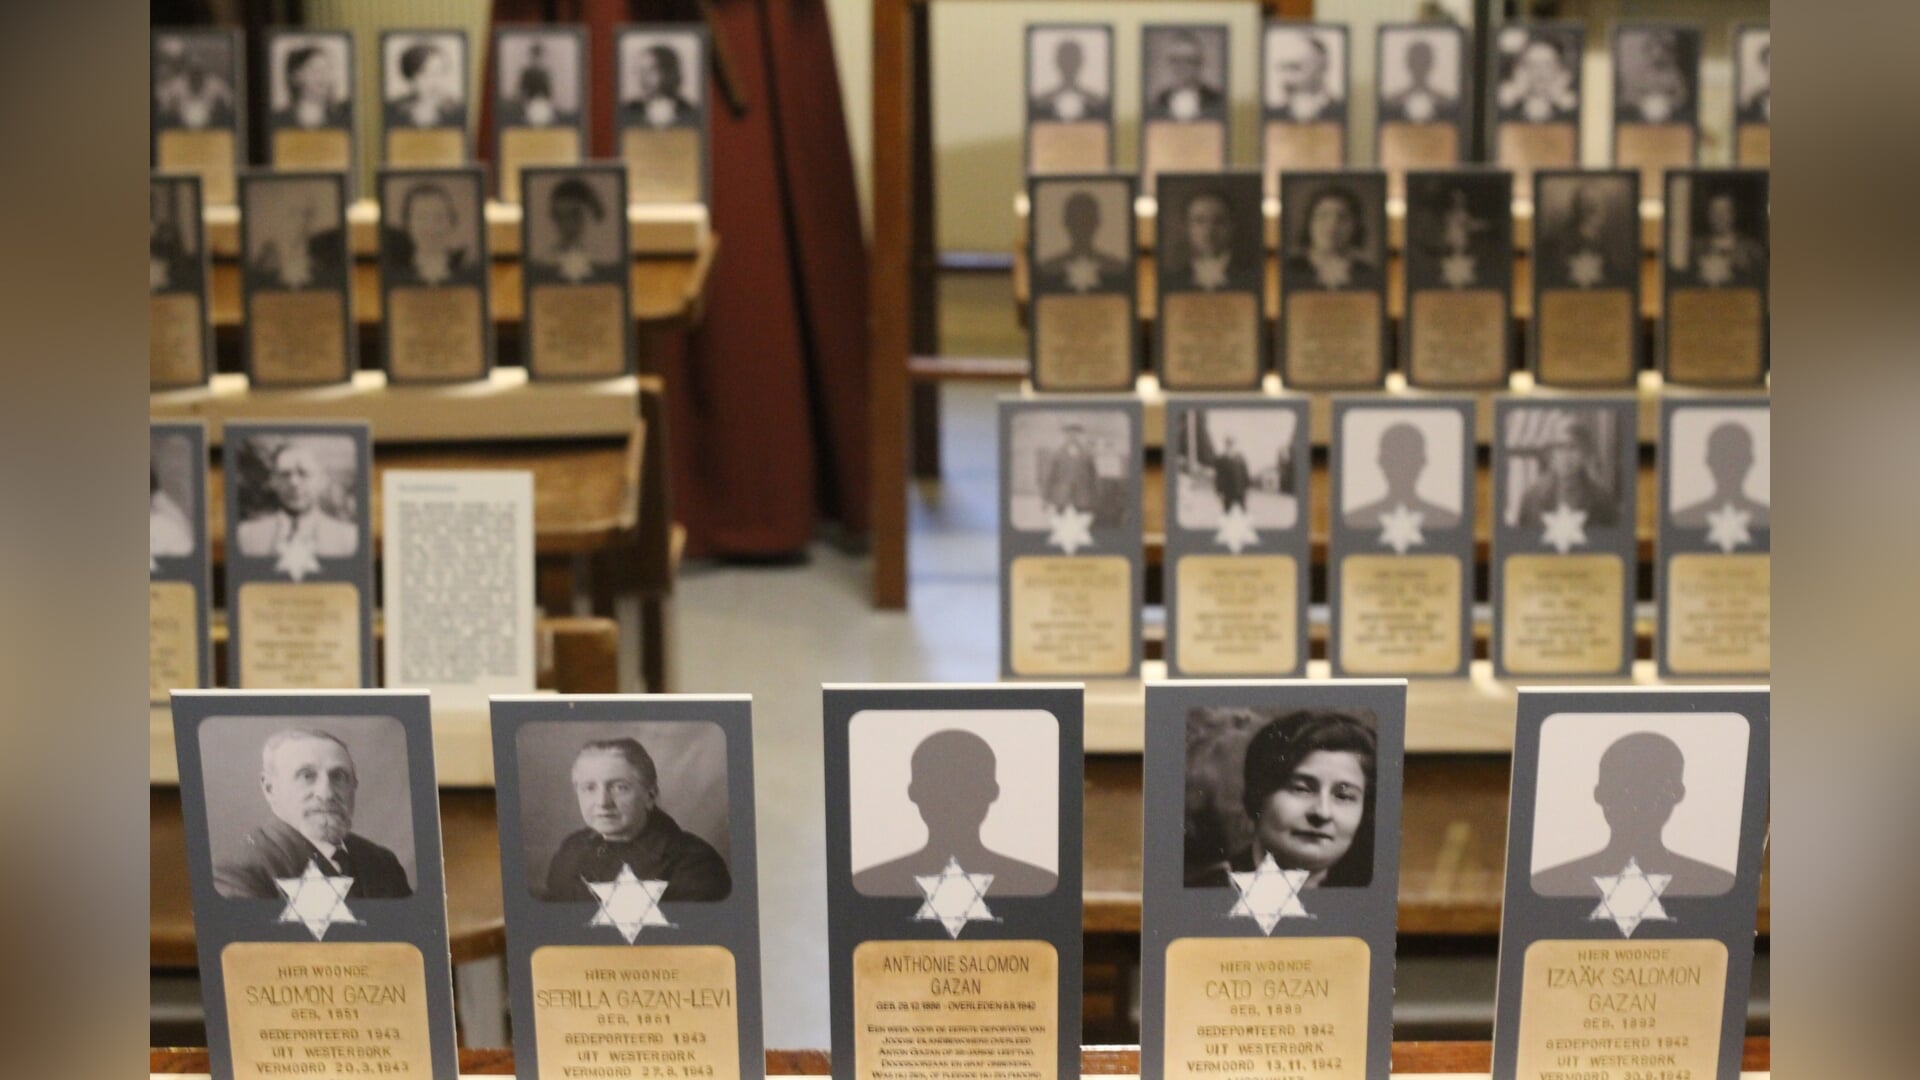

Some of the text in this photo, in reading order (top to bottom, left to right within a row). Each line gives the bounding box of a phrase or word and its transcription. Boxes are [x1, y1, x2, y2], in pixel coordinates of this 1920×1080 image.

[1578, 949, 1671, 961] HIER WOONDE
[278, 965, 369, 977] HIER WOONDE
[882, 955, 1030, 974] ANTHONIE SALOMON
[1220, 959, 1312, 973] HIER WOONDE
[584, 968, 680, 982] HIER WOONDE
[1548, 965, 1701, 988] IZAÄK SALOMON
[931, 978, 981, 996] GAZAN
[1206, 979, 1329, 999] CATO GAZAN
[246, 984, 406, 1005] SALOMON GAZAN
[617, 988, 731, 1008] GAZAN-LEVI
[948, 1001, 1002, 1010] OVERLEDEN
[1589, 993, 1656, 1012] GAZAN
[259, 1027, 400, 1042] GEDEPORTEERD 1943
[1197, 1024, 1335, 1037] GEDEPORTEERD 1942
[565, 1032, 706, 1045] GEDEPORTEERD 1943
[1546, 1036, 1689, 1050] GEDEPORTEERD 1942
[272, 1046, 391, 1059] UIT WESTERBORK
[1206, 1042, 1324, 1056] UIT WESTERBORK
[578, 1050, 696, 1063] UIT WESTERBORK
[1557, 1054, 1676, 1067] UIT WESTERBORK
[256, 1062, 326, 1075] VERMOORD
[562, 1066, 631, 1079] VERMOORD
[1187, 1060, 1254, 1072] VERMOORD
